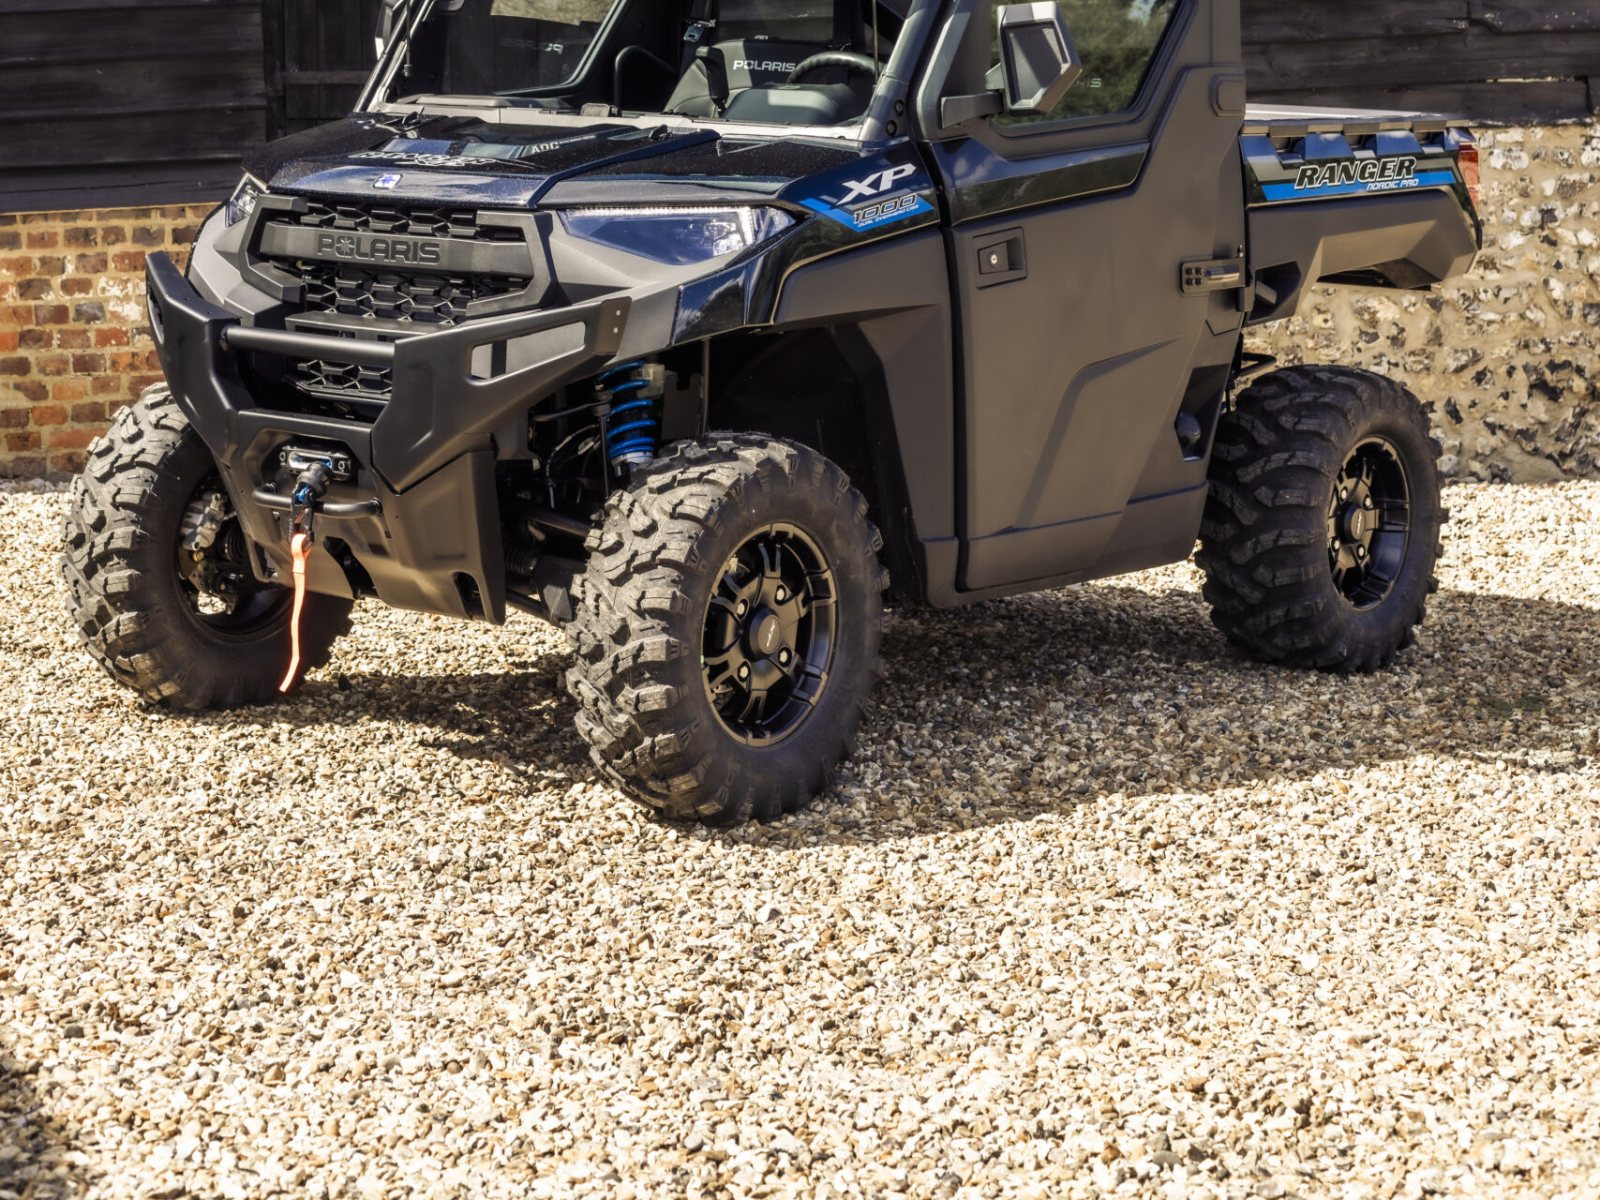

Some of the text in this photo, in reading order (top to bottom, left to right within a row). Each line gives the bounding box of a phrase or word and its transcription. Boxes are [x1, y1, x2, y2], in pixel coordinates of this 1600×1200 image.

[732, 59, 797, 72] POLARIS
[834, 163, 917, 206] XP
[1294, 156, 1417, 190] RANGER
[1366, 178, 1420, 191] NORDIC PRO
[853, 192, 918, 225] 1000
[316, 233, 441, 266] POLARIS
